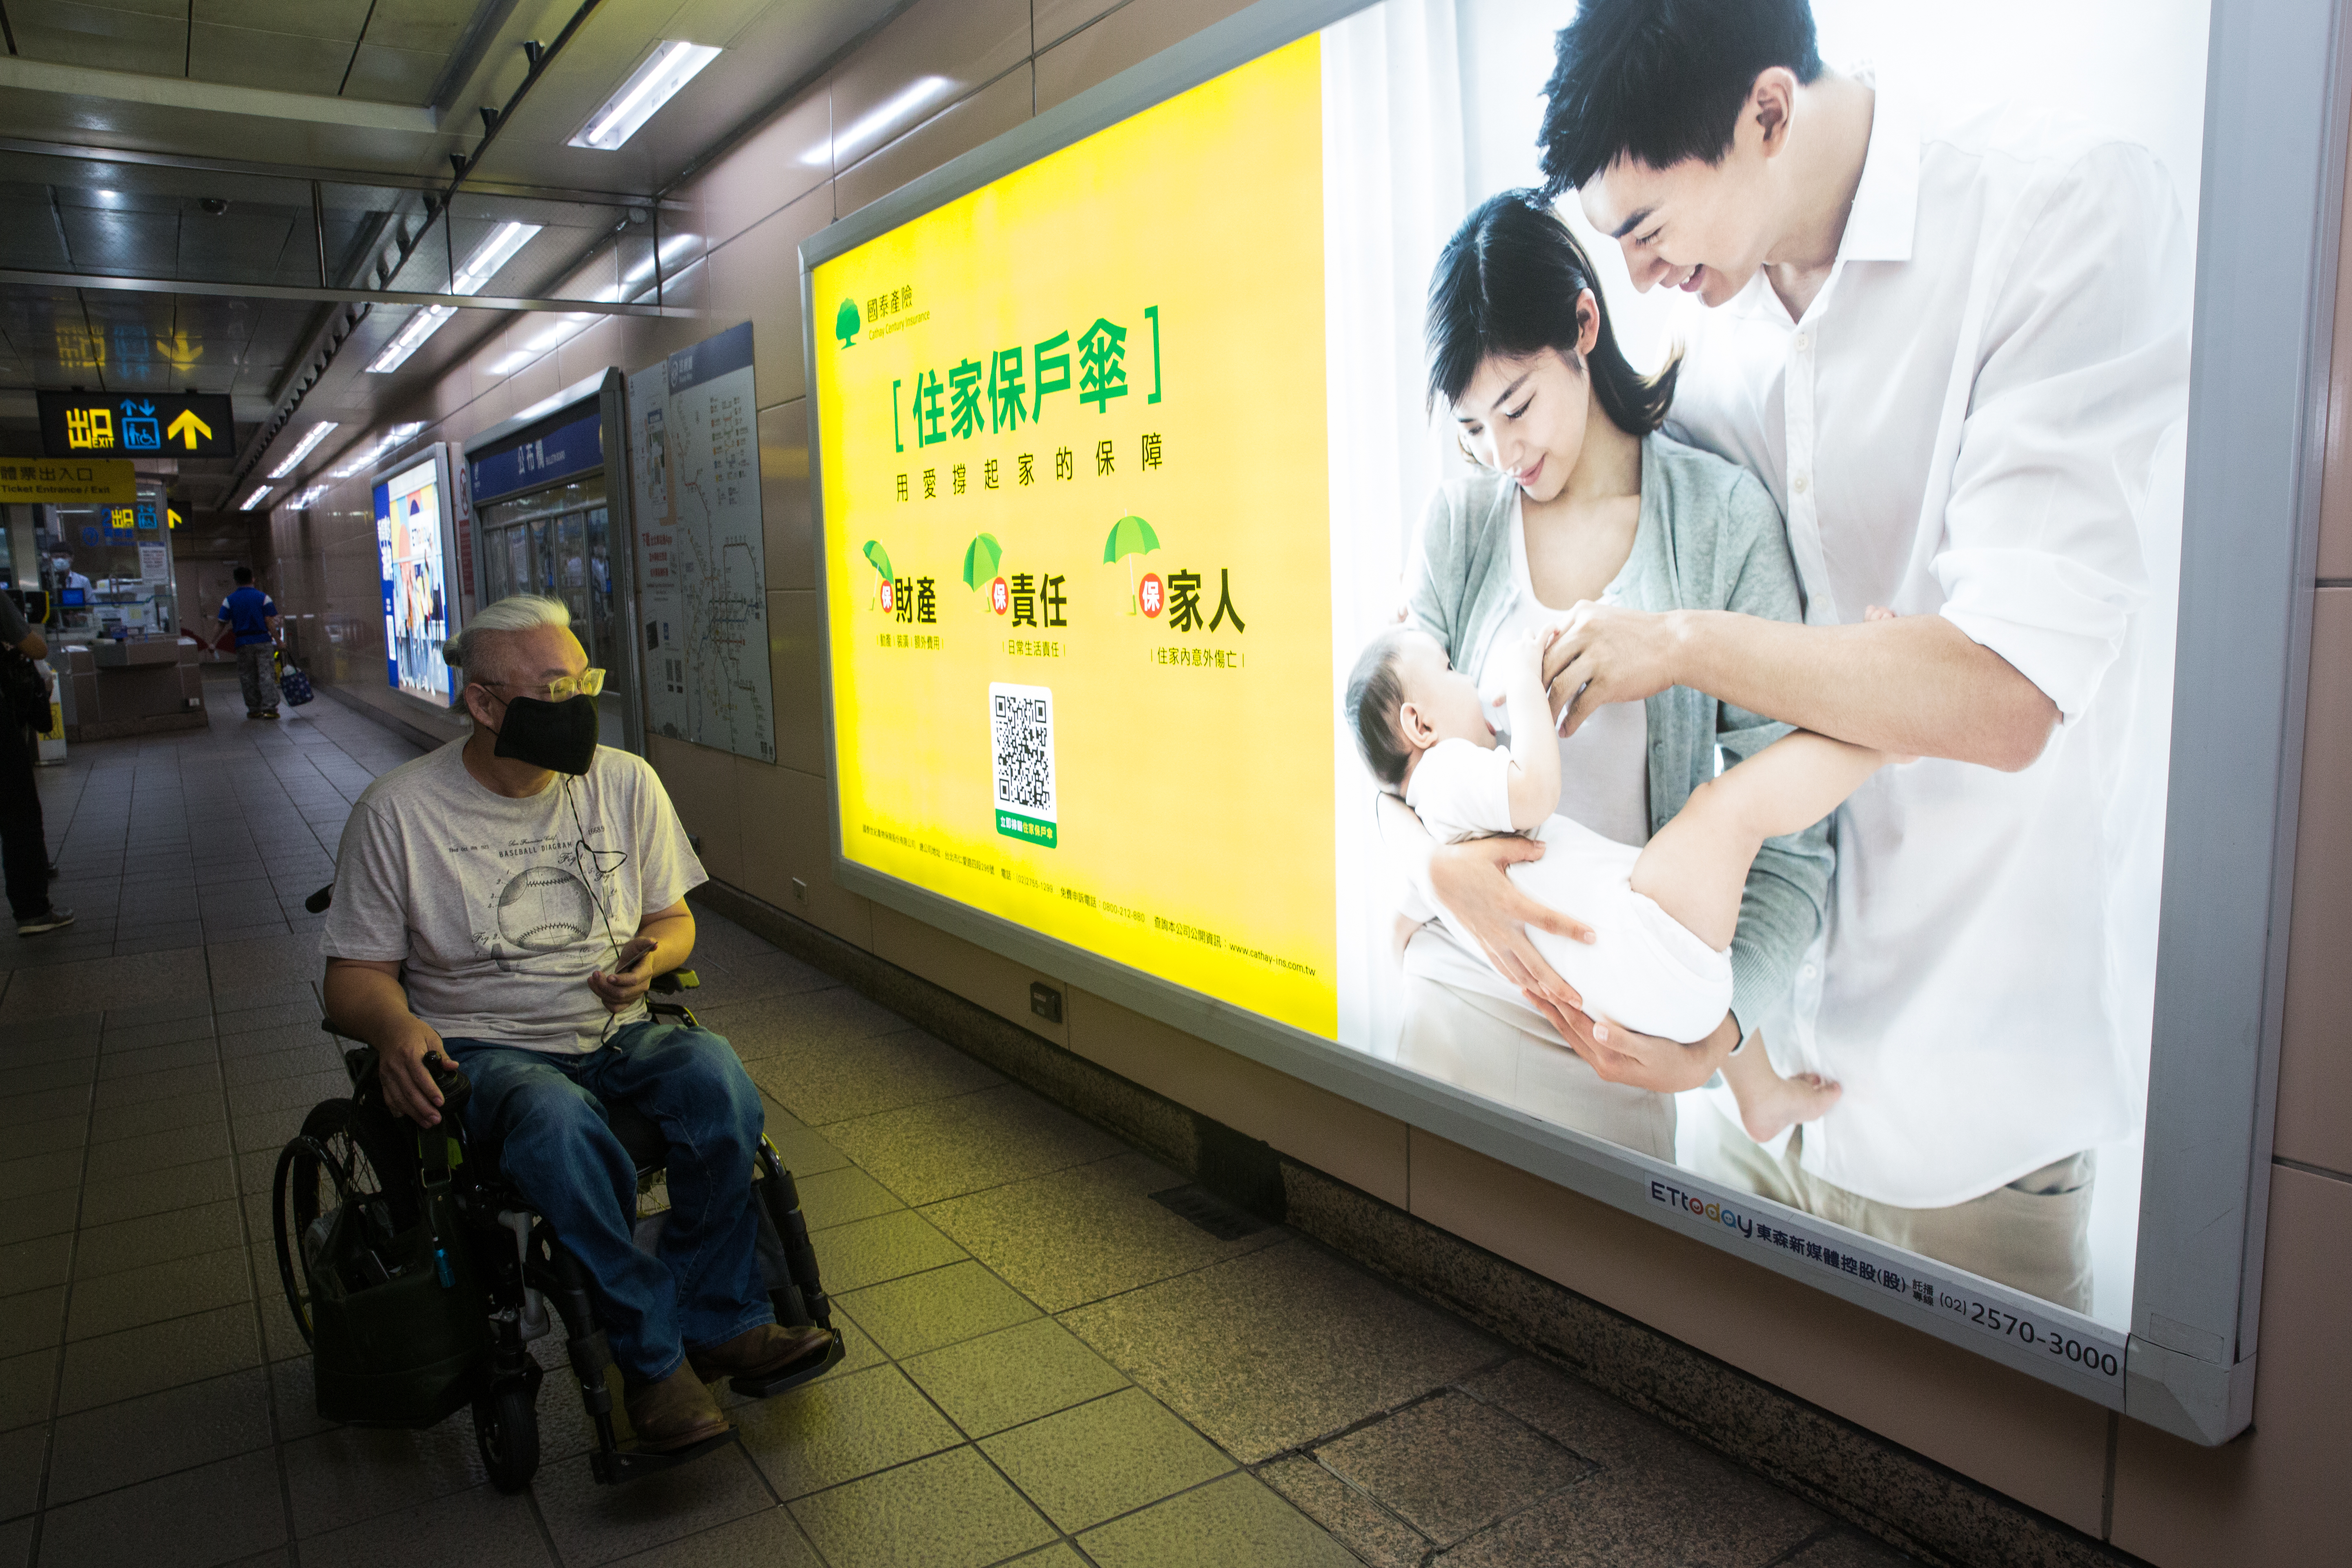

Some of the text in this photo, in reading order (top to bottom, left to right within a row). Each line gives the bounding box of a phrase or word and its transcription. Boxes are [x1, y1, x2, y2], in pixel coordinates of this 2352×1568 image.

[867, 284, 912, 322] 國泰產險
[869, 310, 930, 340] Cathay Century Insurance
[66, 408, 114, 449] 出口
[92, 437, 114, 449] EXIT
[897, 432, 1163, 502] 用愛撐起家的保障
[2, 485, 33, 493] Ticket
[36, 485, 82, 494] Entrance
[1008, 640, 1060, 657] 日常生活責任
[1158, 647, 1237, 668] 住家內意外傷亡
[499, 842, 572, 858] BASEBALL DIAGRAM
[472, 932, 489, 944] Fig
[1651, 1180, 1753, 1238] ETtoday
[1940, 1292, 2118, 1376] (02) 2570-3000
